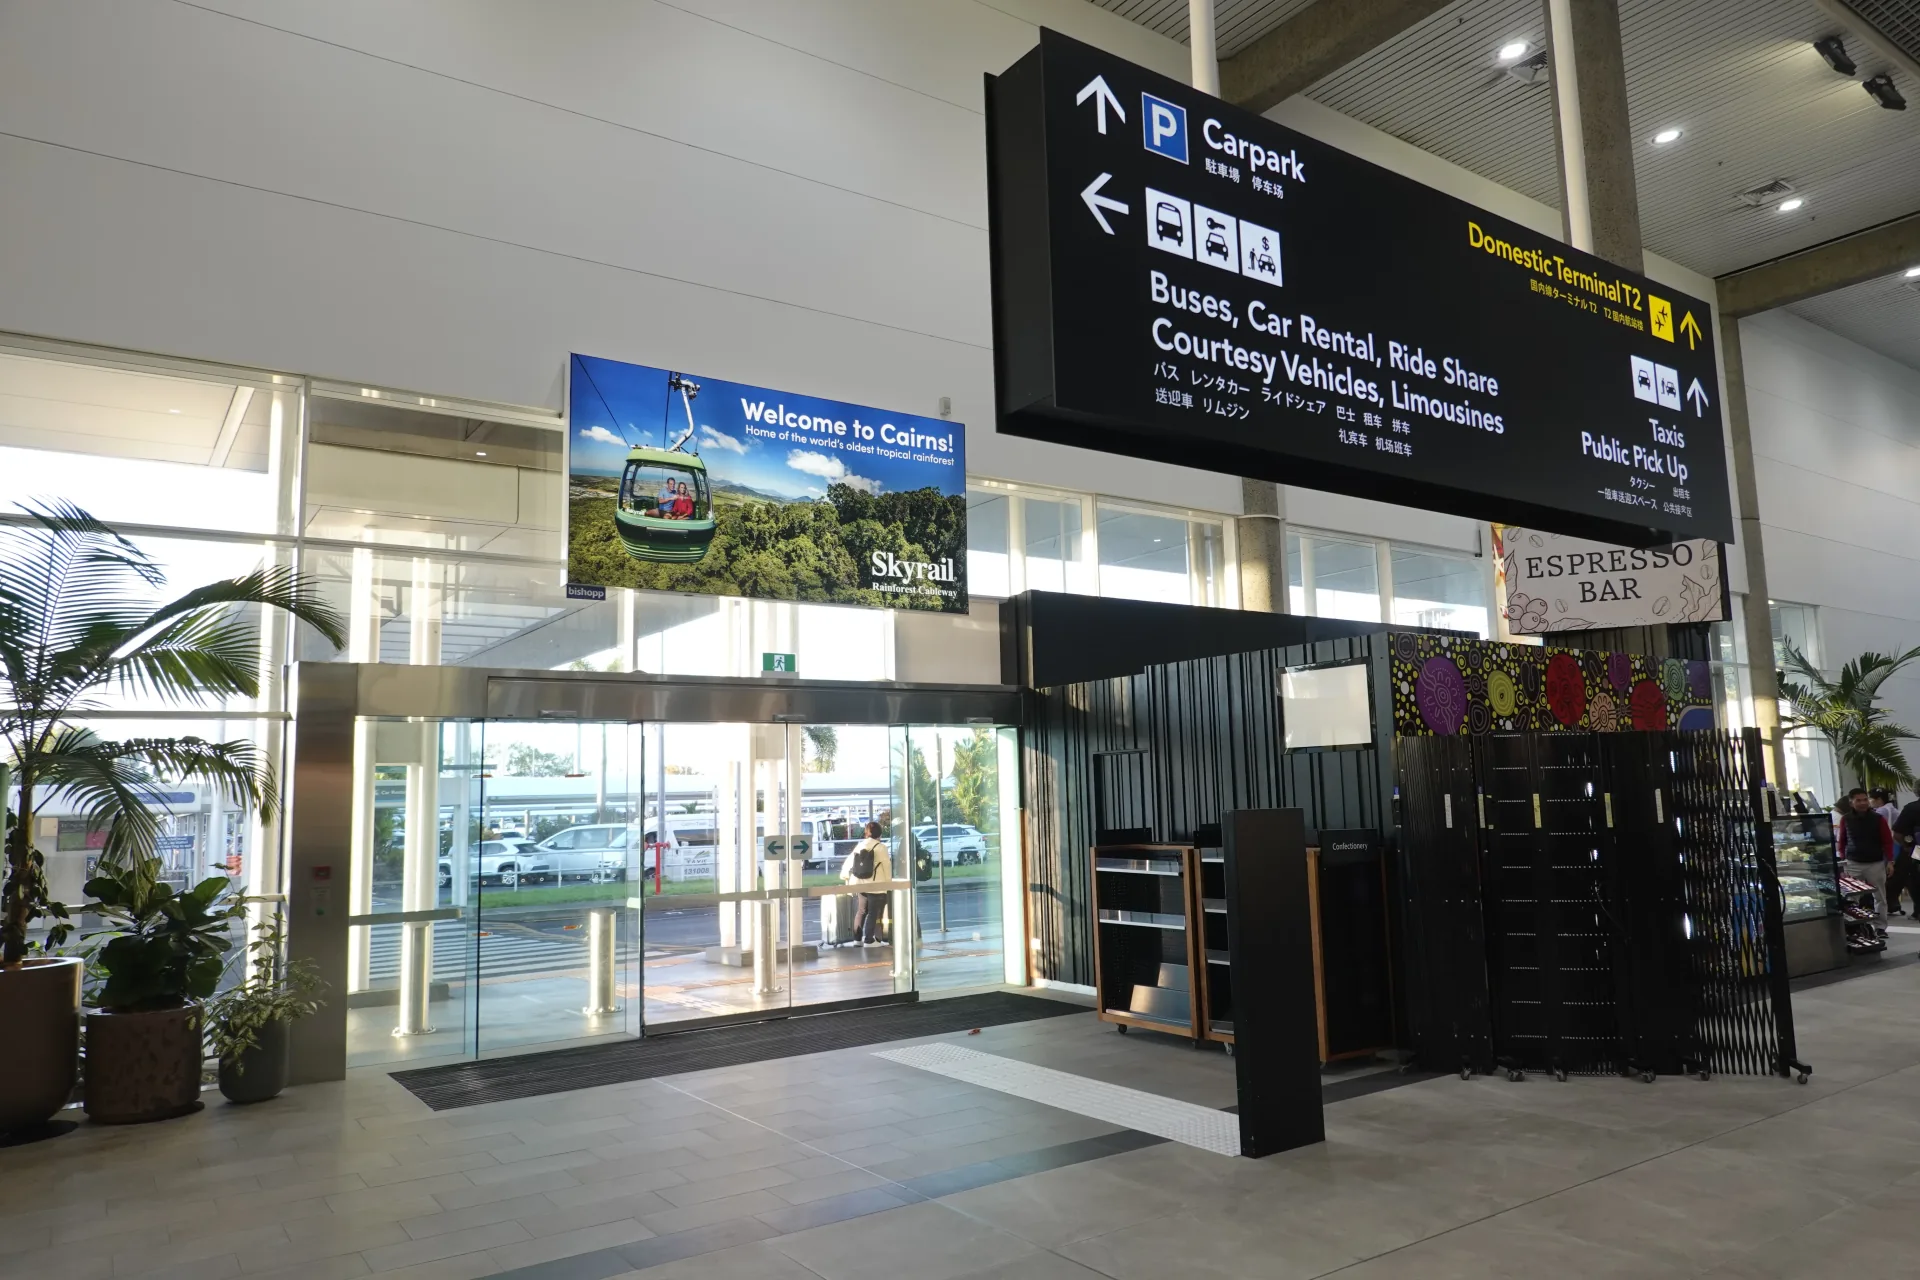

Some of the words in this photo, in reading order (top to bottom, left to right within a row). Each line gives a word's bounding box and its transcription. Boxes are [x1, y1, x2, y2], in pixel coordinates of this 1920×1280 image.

[1202, 118, 1306, 182] Carpark
[1205, 158, 1240, 184] 駐車場
[1252, 175, 1284, 200] 停车场
[1468, 222, 1552, 277] Domestic
[1553, 254, 1621, 303] Terminal
[1622, 283, 1642, 312] T2
[1589, 302, 1598, 314] T2
[1604, 307, 1612, 320] T2
[1151, 271, 1239, 329] Buses,
[1247, 301, 1292, 338] Car
[1300, 314, 1382, 369] Rental,
[1389, 341, 1436, 379] Ride
[1443, 358, 1498, 396] Share
[1152, 318, 1276, 384] Courtesy
[1281, 350, 1384, 410] Vehicles,
[1392, 382, 1504, 435] Limousines
[1154, 362, 1180, 382] バス
[1192, 370, 1250, 396] レンタカー
[1260, 388, 1326, 415] ライドシェア
[1156, 388, 1194, 409] 送迎車
[1203, 398, 1250, 420] リムジン
[741, 398, 846, 436] Welcome
[852, 420, 874, 440] to
[880, 424, 953, 452] Cairns!
[1336, 406, 1356, 422] 巴士
[1363, 412, 1382, 428] 租车
[1392, 418, 1411, 435] 拼车
[1649, 418, 1686, 448] Taxis
[746, 425, 776, 439] Home
[779, 430, 789, 441] of
[792, 432, 807, 444] the
[847, 442, 874, 454] oldest
[877, 446, 910, 460] tropical
[913, 452, 954, 466] rainforest
[1338, 428, 1368, 447] 礼宾车
[1375, 436, 1412, 457] 机场班车
[1582, 431, 1630, 466] Public
[1633, 445, 1664, 474] Pick
[1667, 454, 1688, 485] Up
[1630, 476, 1656, 490] タクシー
[1673, 486, 1690, 500] 出租车
[872, 551, 954, 584] Skyrail
[1526, 544, 1693, 578] ESPRESSO
[568, 586, 604, 598] bishopp
[872, 582, 916, 594] Rainforest
[918, 586, 957, 598] Cableway
[1578, 577, 1642, 603] BAR
[1332, 842, 1368, 850] Confectionery
